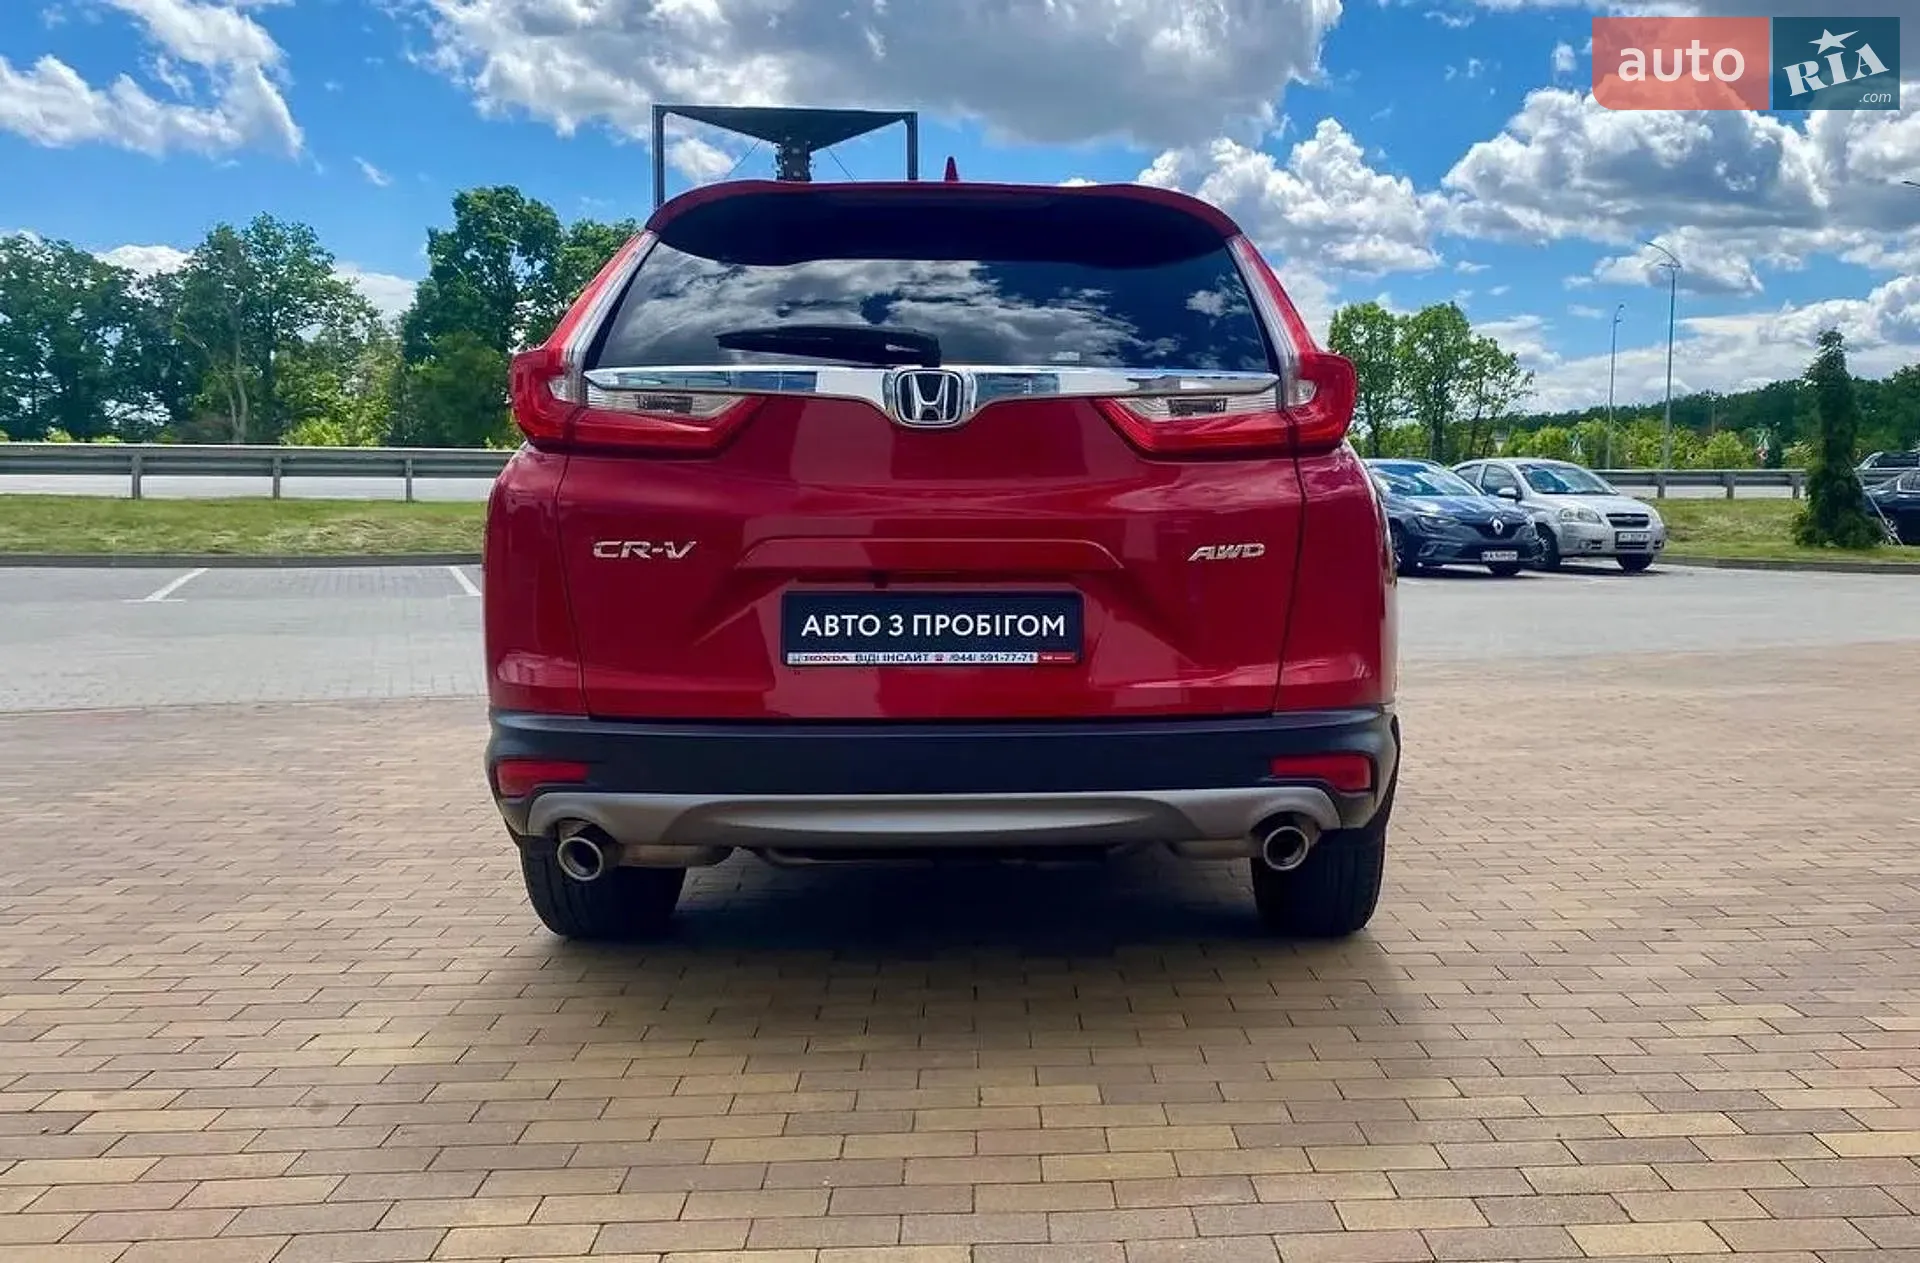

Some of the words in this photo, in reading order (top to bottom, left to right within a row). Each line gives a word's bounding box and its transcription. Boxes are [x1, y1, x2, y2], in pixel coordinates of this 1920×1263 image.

[593, 540, 697, 560] CR-V
[1187, 542, 1266, 562] AWD
[801, 614, 881, 637] АВТО
[888, 614, 904, 637] З
[912, 614, 1065, 637] ПРОБІГОМ
[980, 653, 1035, 663] 591-77-71
